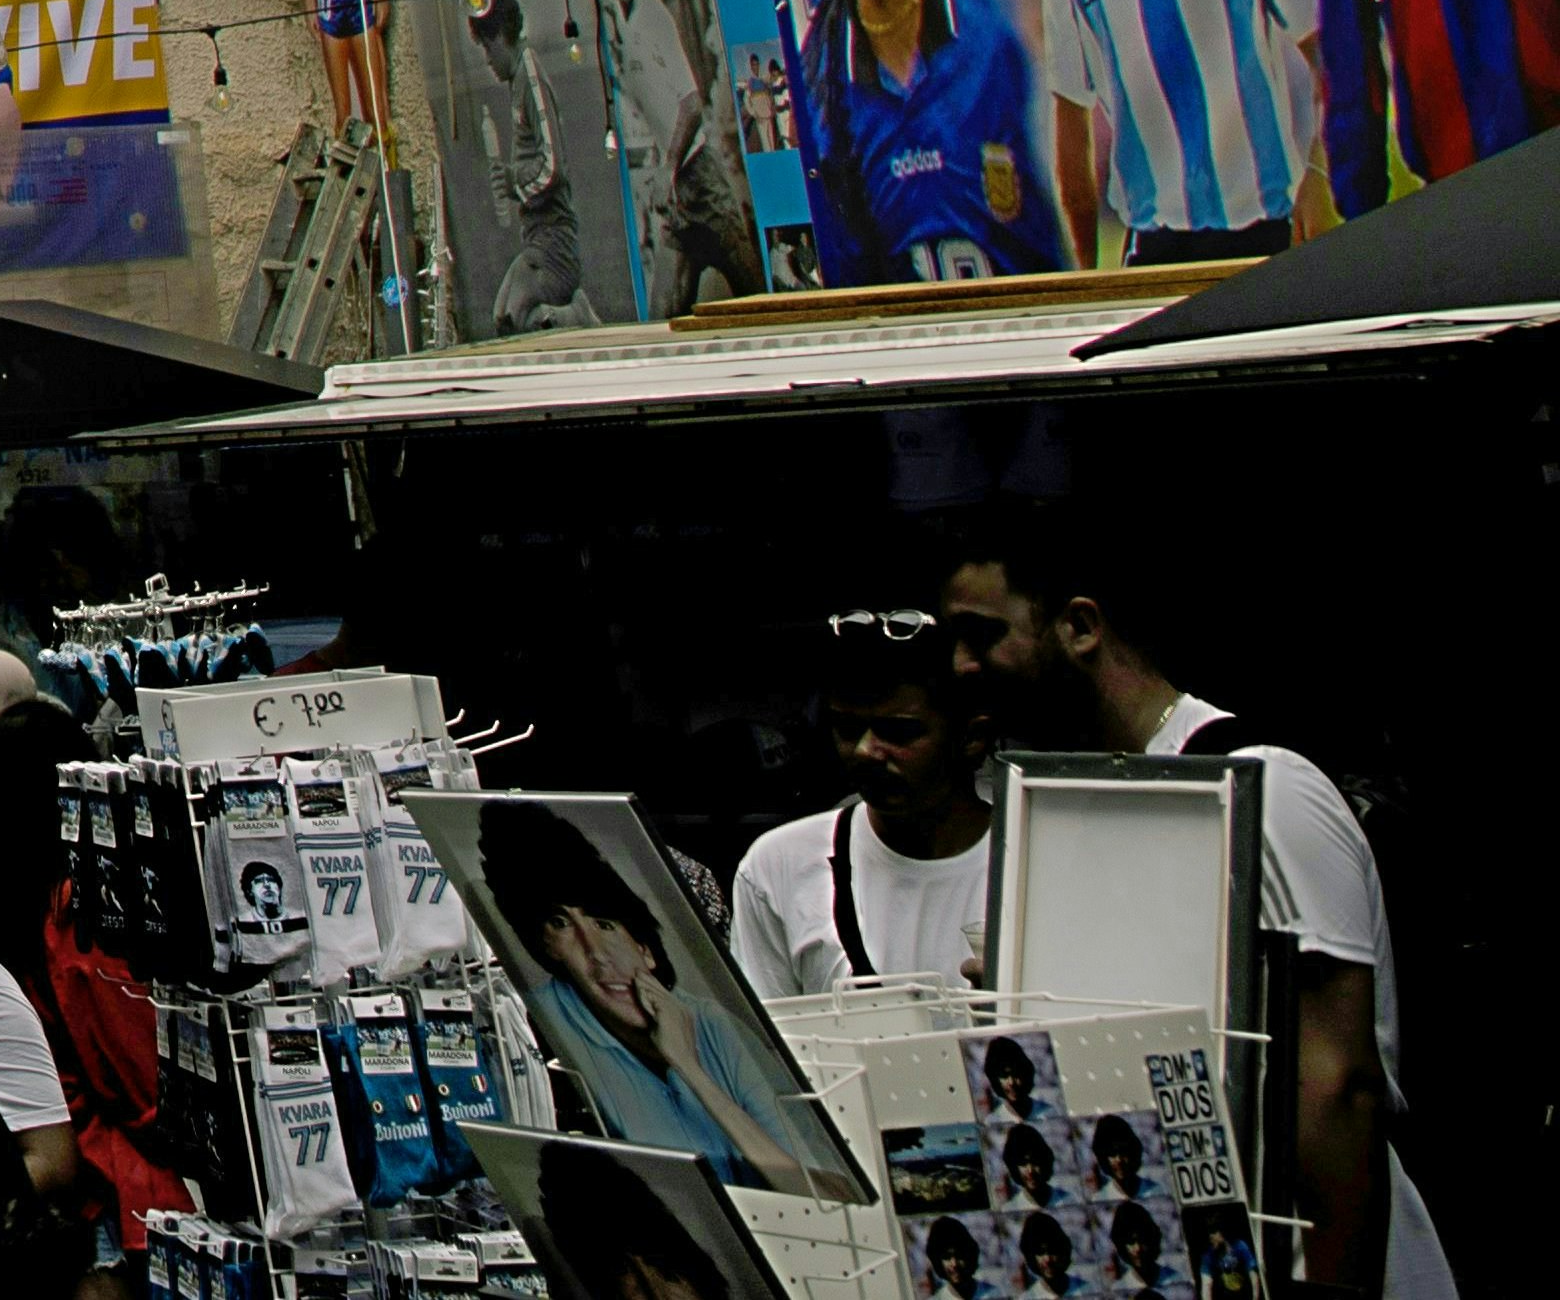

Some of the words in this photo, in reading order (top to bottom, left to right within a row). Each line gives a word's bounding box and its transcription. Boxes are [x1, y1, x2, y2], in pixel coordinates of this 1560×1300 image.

[890, 147, 944, 179] adidas
[253, 697, 284, 736] €
[232, 820, 281, 832] MARADONA
[311, 817, 341, 829] NAPOLI
[309, 853, 364, 874] KVARA
[316, 874, 363, 916] 77
[404, 865, 448, 905] 77
[364, 1056, 410, 1069] MARADONA
[427, 1048, 475, 1062] MARADONA
[281, 1066, 312, 1077] NAPOLI
[278, 1099, 332, 1125] KVARA
[440, 1096, 494, 1122] Buitoni
[1158, 1084, 1213, 1124] DIOS
[375, 1117, 428, 1143] Buitoni
[288, 1122, 332, 1167] 77
[1176, 1160, 1232, 1199] DIOS
